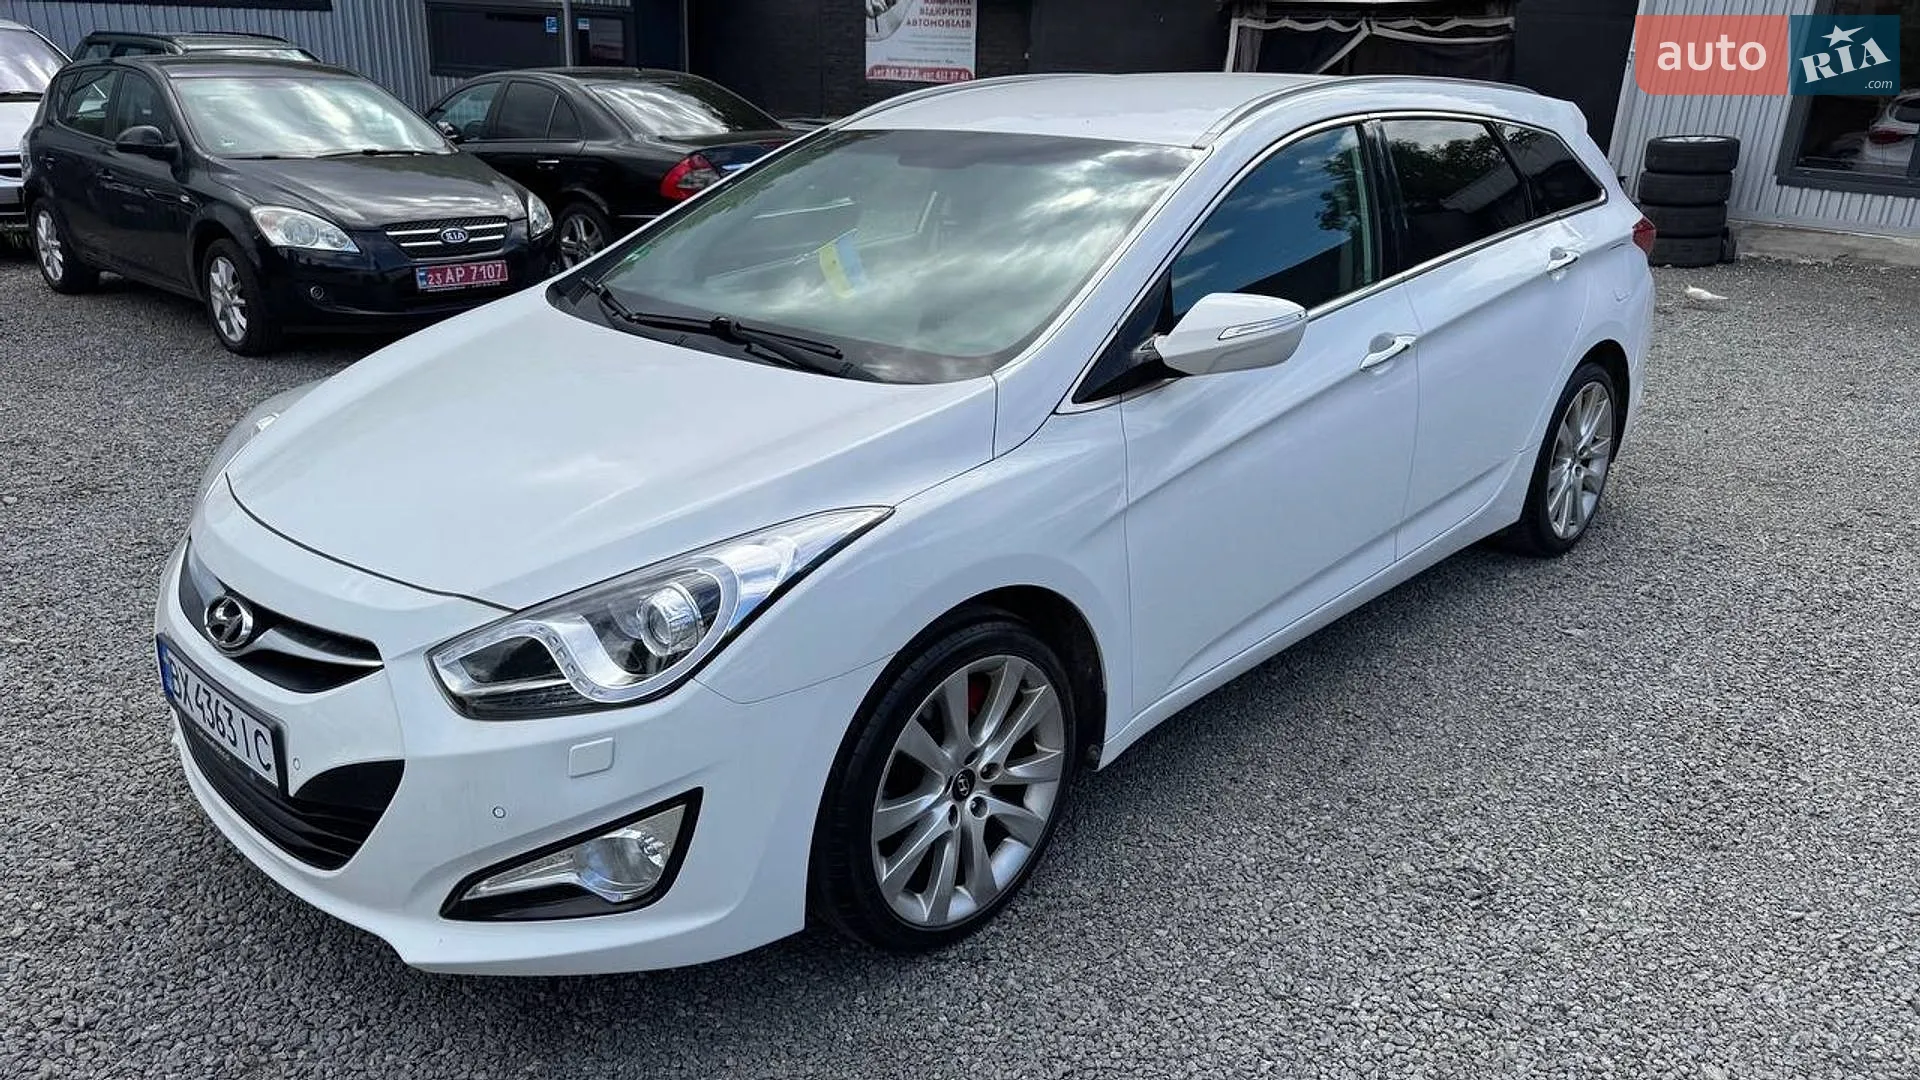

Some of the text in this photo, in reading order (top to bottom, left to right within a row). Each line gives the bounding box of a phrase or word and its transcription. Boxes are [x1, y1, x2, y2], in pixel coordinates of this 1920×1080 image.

[446, 231, 465, 240] KIA
[445, 268, 465, 282] AP
[470, 264, 502, 280] 7107
[195, 684, 237, 747] 4363
